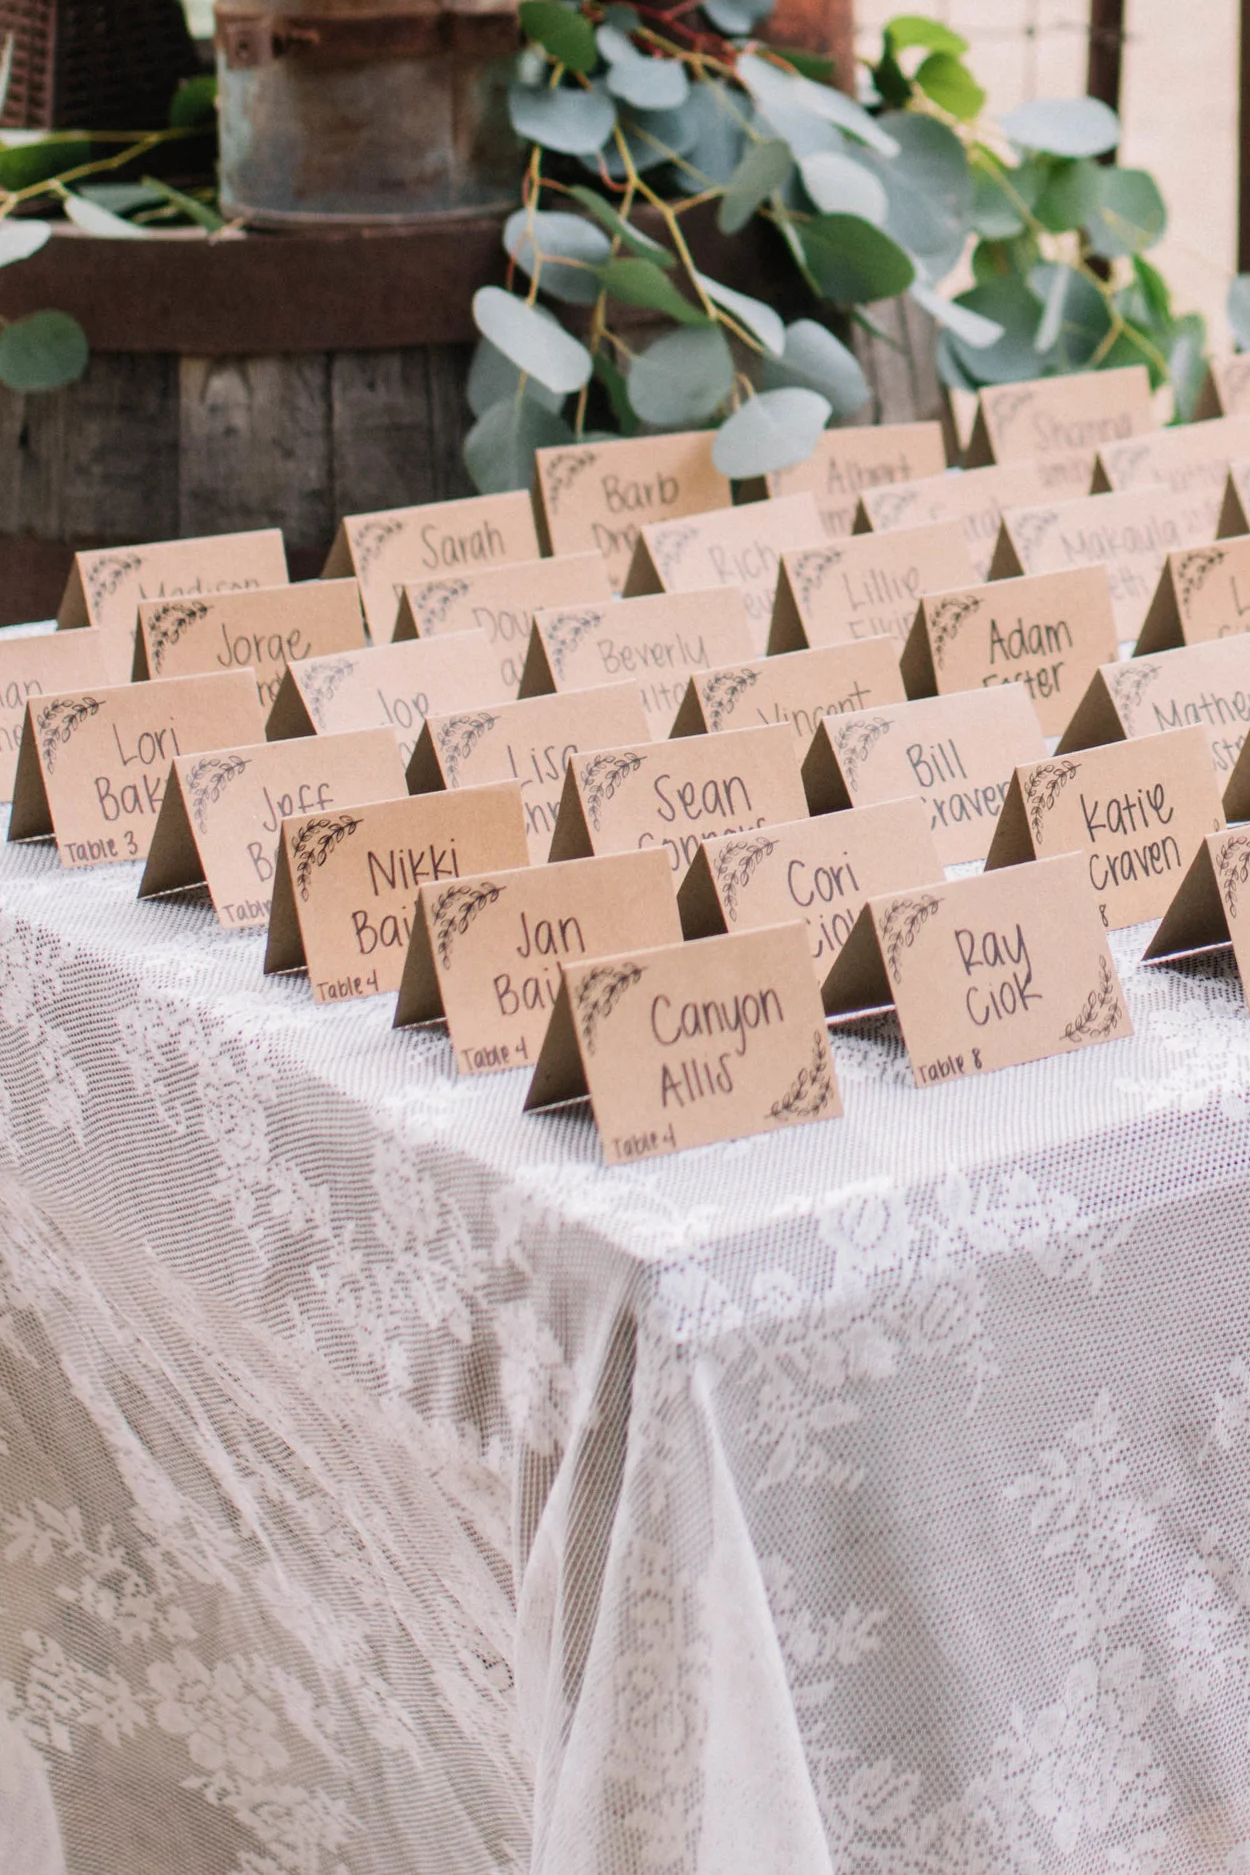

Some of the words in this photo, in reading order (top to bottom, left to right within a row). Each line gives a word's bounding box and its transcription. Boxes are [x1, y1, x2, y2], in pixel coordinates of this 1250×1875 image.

[601, 471, 679, 513] Barb
[420, 519, 506, 569] Sarah
[217, 623, 312, 668] Jorge
[472, 606, 544, 645] Dou
[989, 616, 1074, 665] Adam
[597, 633, 710, 675] Beverly
[112, 715, 181, 767] Lori
[906, 737, 968, 789] Bill
[654, 774, 752, 823] Sean
[920, 780, 1013, 831] raven
[1079, 782, 1175, 843] Katie
[64, 836, 119, 865] Table
[123, 829, 139, 857] 3
[366, 838, 461, 897] Nikki
[1089, 834, 1182, 892] Craven
[787, 850, 861, 908] Cori
[515, 912, 586, 959] Jan
[954, 923, 1033, 987] Ray
[316, 973, 364, 1002] Table
[365, 968, 380, 992] 4
[650, 985, 785, 1057] Canyon
[460, 1045, 511, 1073] Table
[514, 1035, 529, 1060] 4
[917, 1054, 965, 1084] Table
[970, 1047, 984, 1071] 8
[611, 1131, 658, 1161] Table
